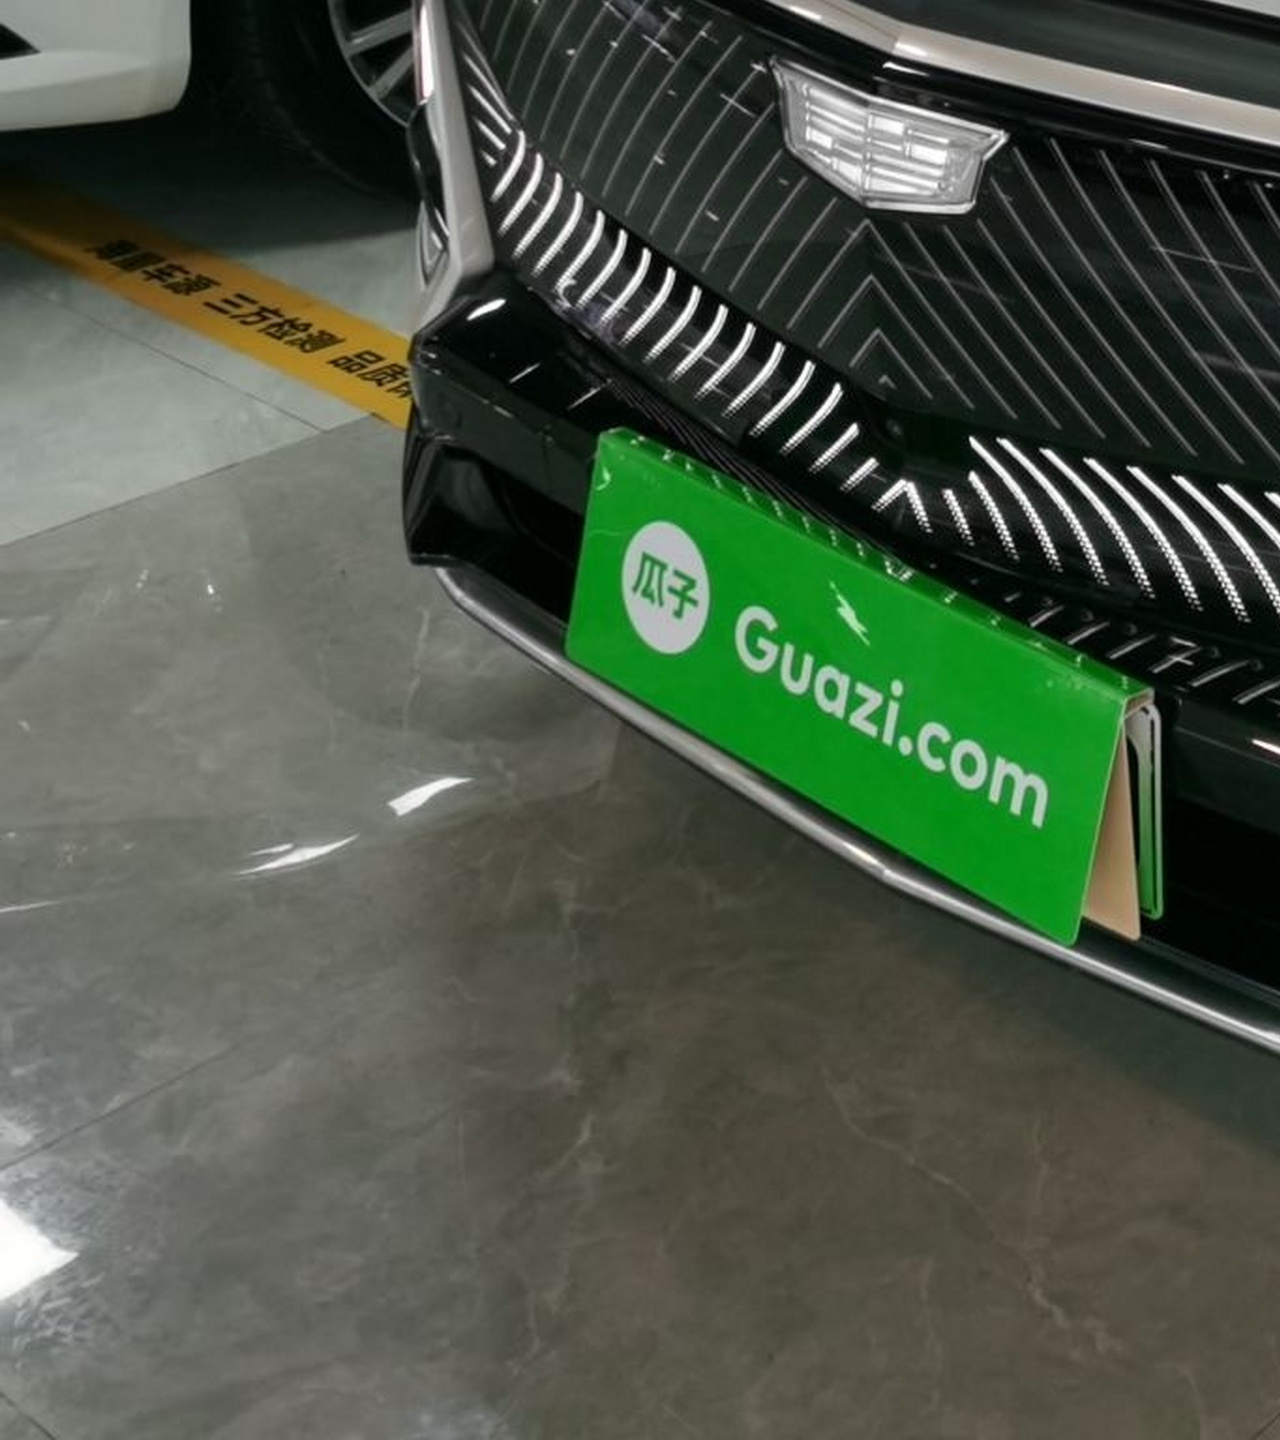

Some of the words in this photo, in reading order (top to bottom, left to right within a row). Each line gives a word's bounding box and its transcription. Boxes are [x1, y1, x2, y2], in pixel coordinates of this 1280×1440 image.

[203, 293, 346, 353] 三方检测
[631, 551, 699, 621] 瓜子
[734, 605, 1049, 828] Guazi.com
